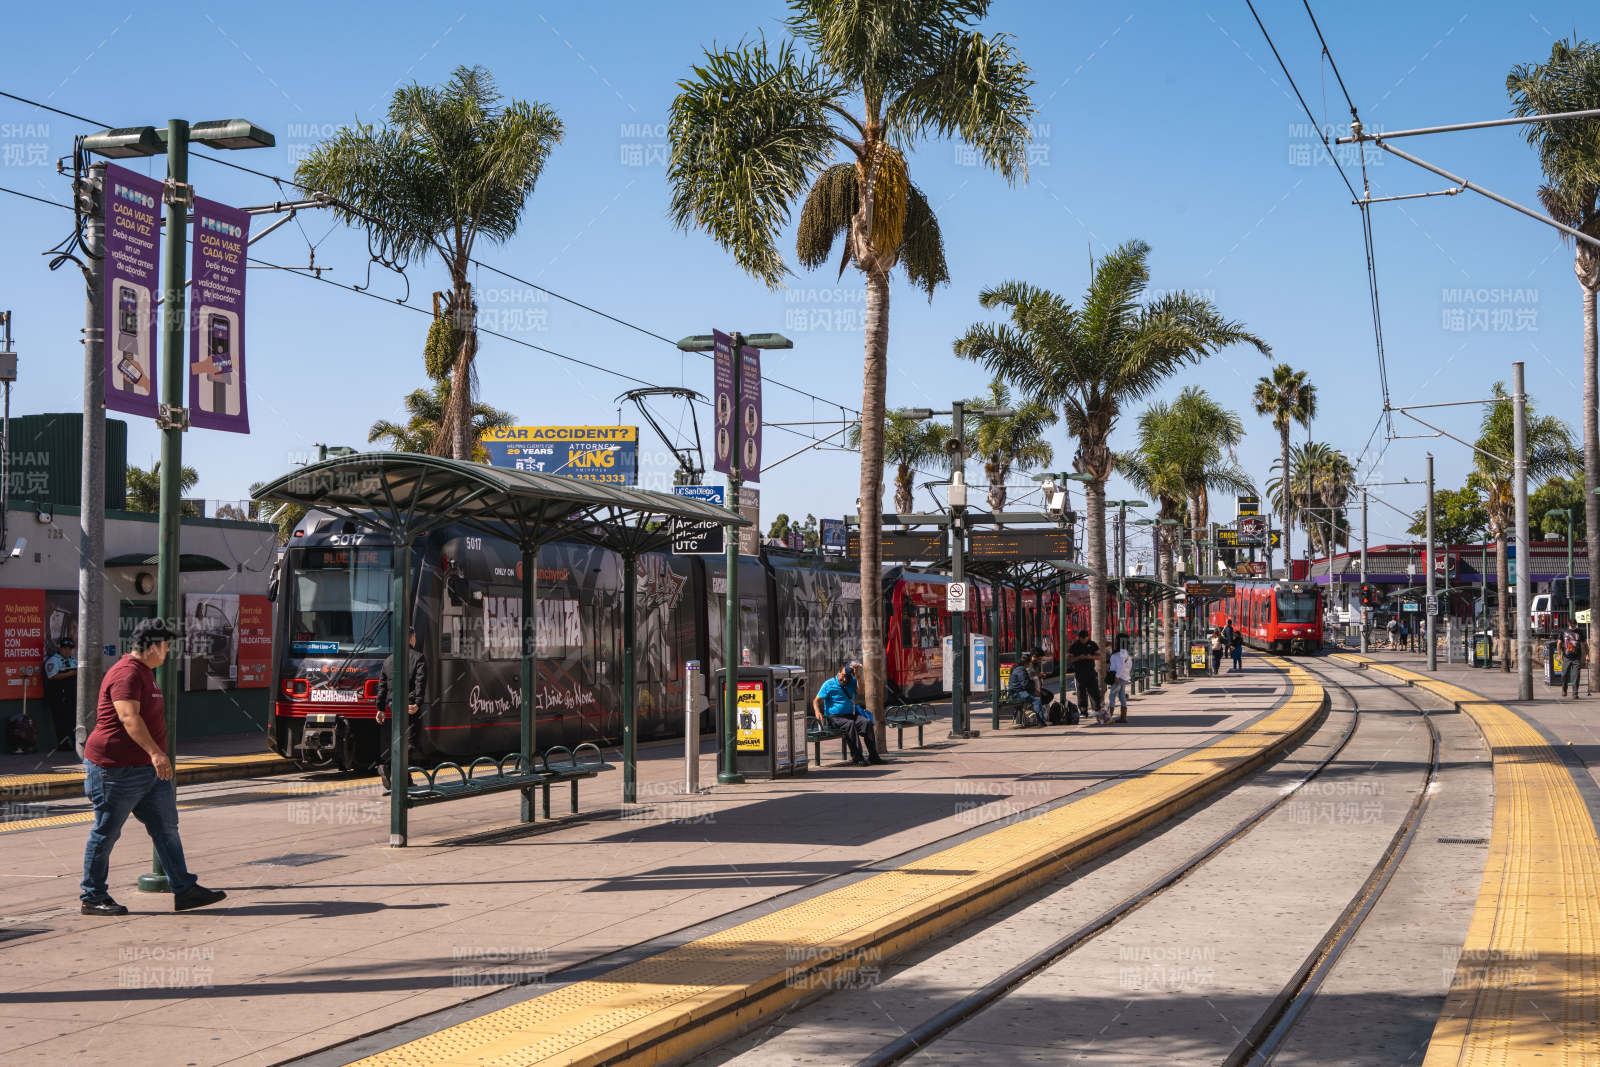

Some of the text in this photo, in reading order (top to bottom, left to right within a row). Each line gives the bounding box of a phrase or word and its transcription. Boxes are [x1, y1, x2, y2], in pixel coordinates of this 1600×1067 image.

[114, 184, 155, 209] PRONTO
[113, 202, 133, 217] CADA
[115, 215, 136, 231] CADA
[201, 216, 242, 239] PRONTO
[112, 228, 154, 249] Debe escanear
[199, 233, 221, 247] CADA
[133, 247, 141, 255] un
[202, 246, 223, 260] CADA
[111, 250, 154, 270] validador antes
[116, 261, 124, 272] de
[205, 259, 236, 275] Debe tocar
[198, 279, 241, 296] validador antes
[494, 428, 629, 439] CAR ACCIDENT?
[568, 450, 615, 468] KING
[515, 462, 545, 472] BEST
[697, 488, 714, 497] Diego
[329, 534, 365, 546] 5017
[466, 537, 482, 551] 5017
[675, 541, 698, 550] UTC
[323, 552, 379, 563] BLUE LINE
[495, 567, 506, 576] ONLY
[507, 568, 515, 576] ON
[4, 628, 41, 638] NO VIAJES
[4, 638, 21, 648] CON
[4, 648, 41, 657] RAITEROS.
[469, 685, 494, 715] Burn
